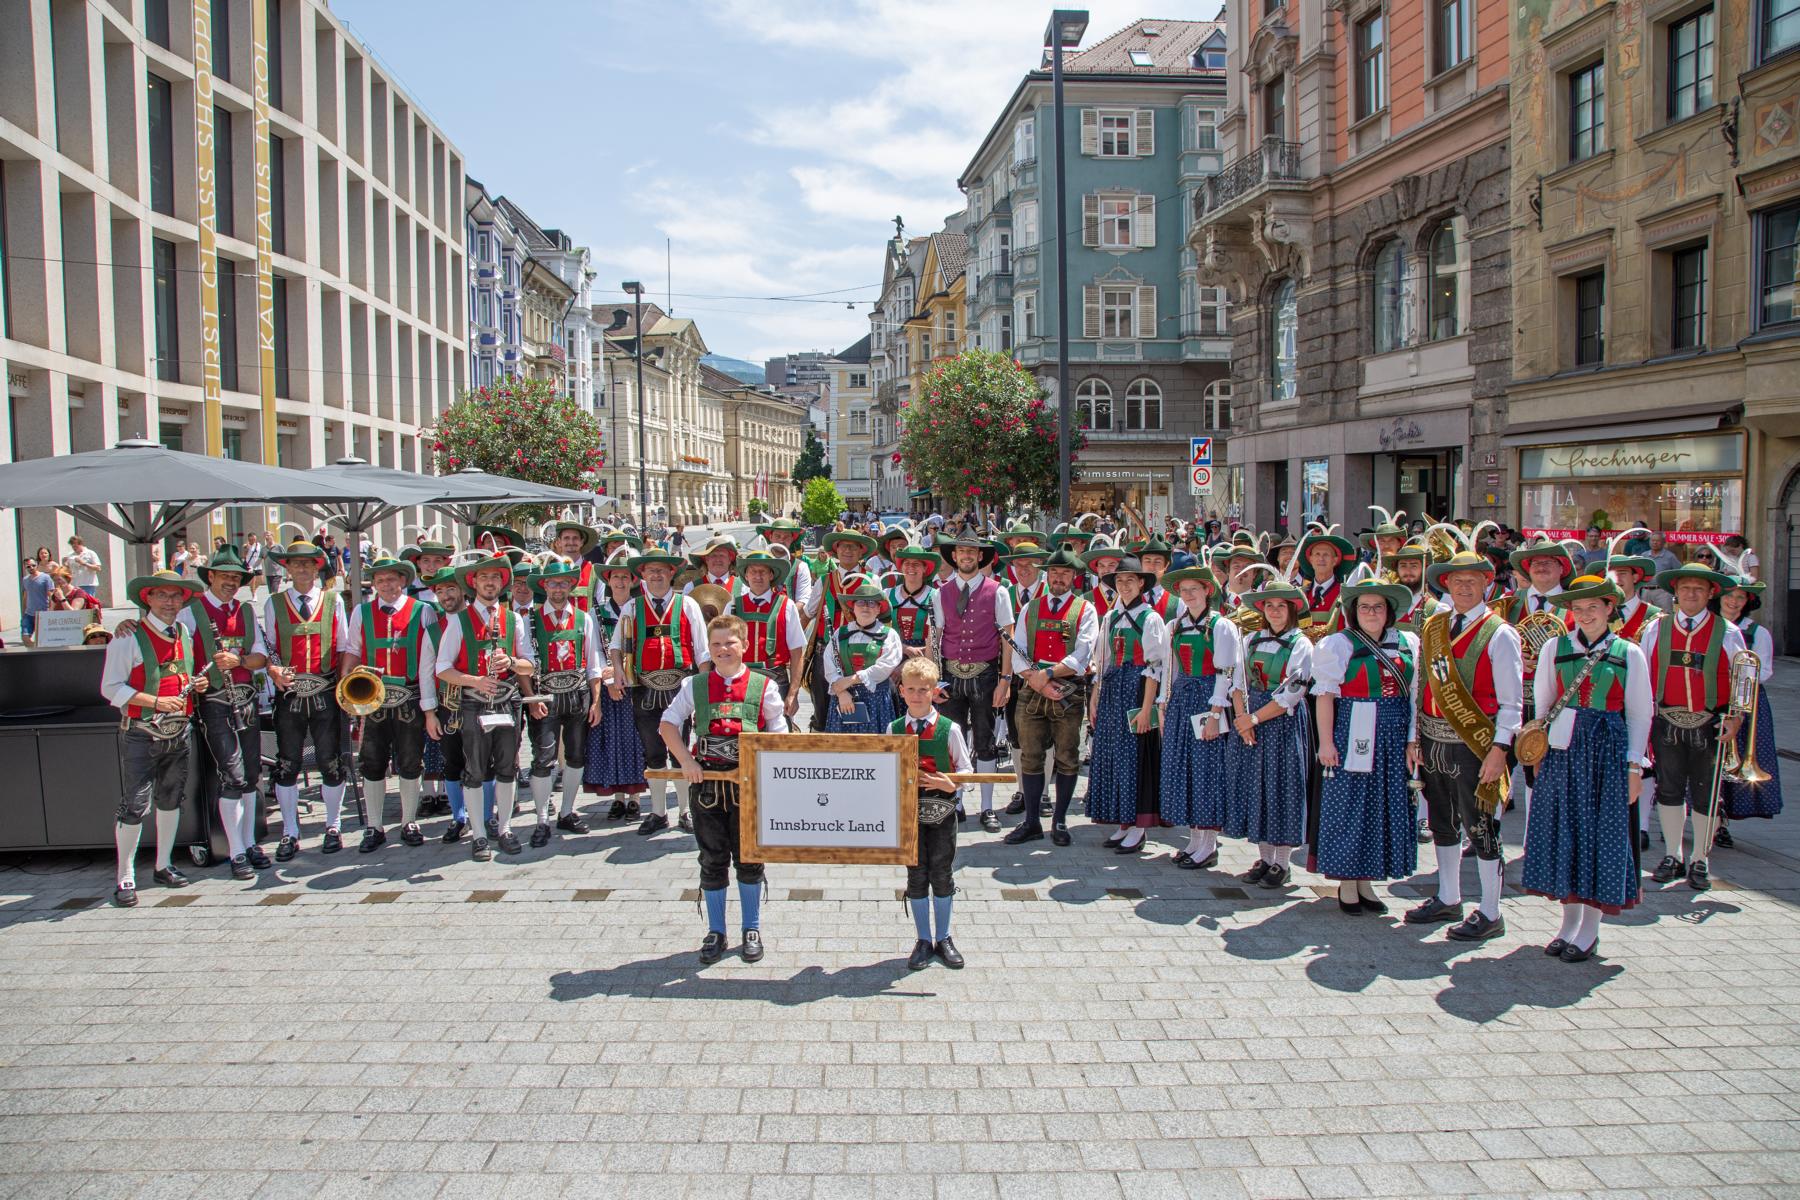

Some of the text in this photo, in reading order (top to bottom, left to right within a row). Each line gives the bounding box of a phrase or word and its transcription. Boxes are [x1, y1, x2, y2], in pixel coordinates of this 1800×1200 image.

[194, 0, 221, 401] FIRST CLASS SHOPPI
[256, 162, 275, 351] KAUFHAUS
[1197, 472, 1207, 481] 30
[1193, 487, 1210, 495] Zone
[1669, 534, 1697, 542] SUMMER
[1698, 535, 1714, 543] SALE
[773, 767, 876, 780] MUSIKBEZIRK
[770, 819, 885, 832] Innsbruck Land
